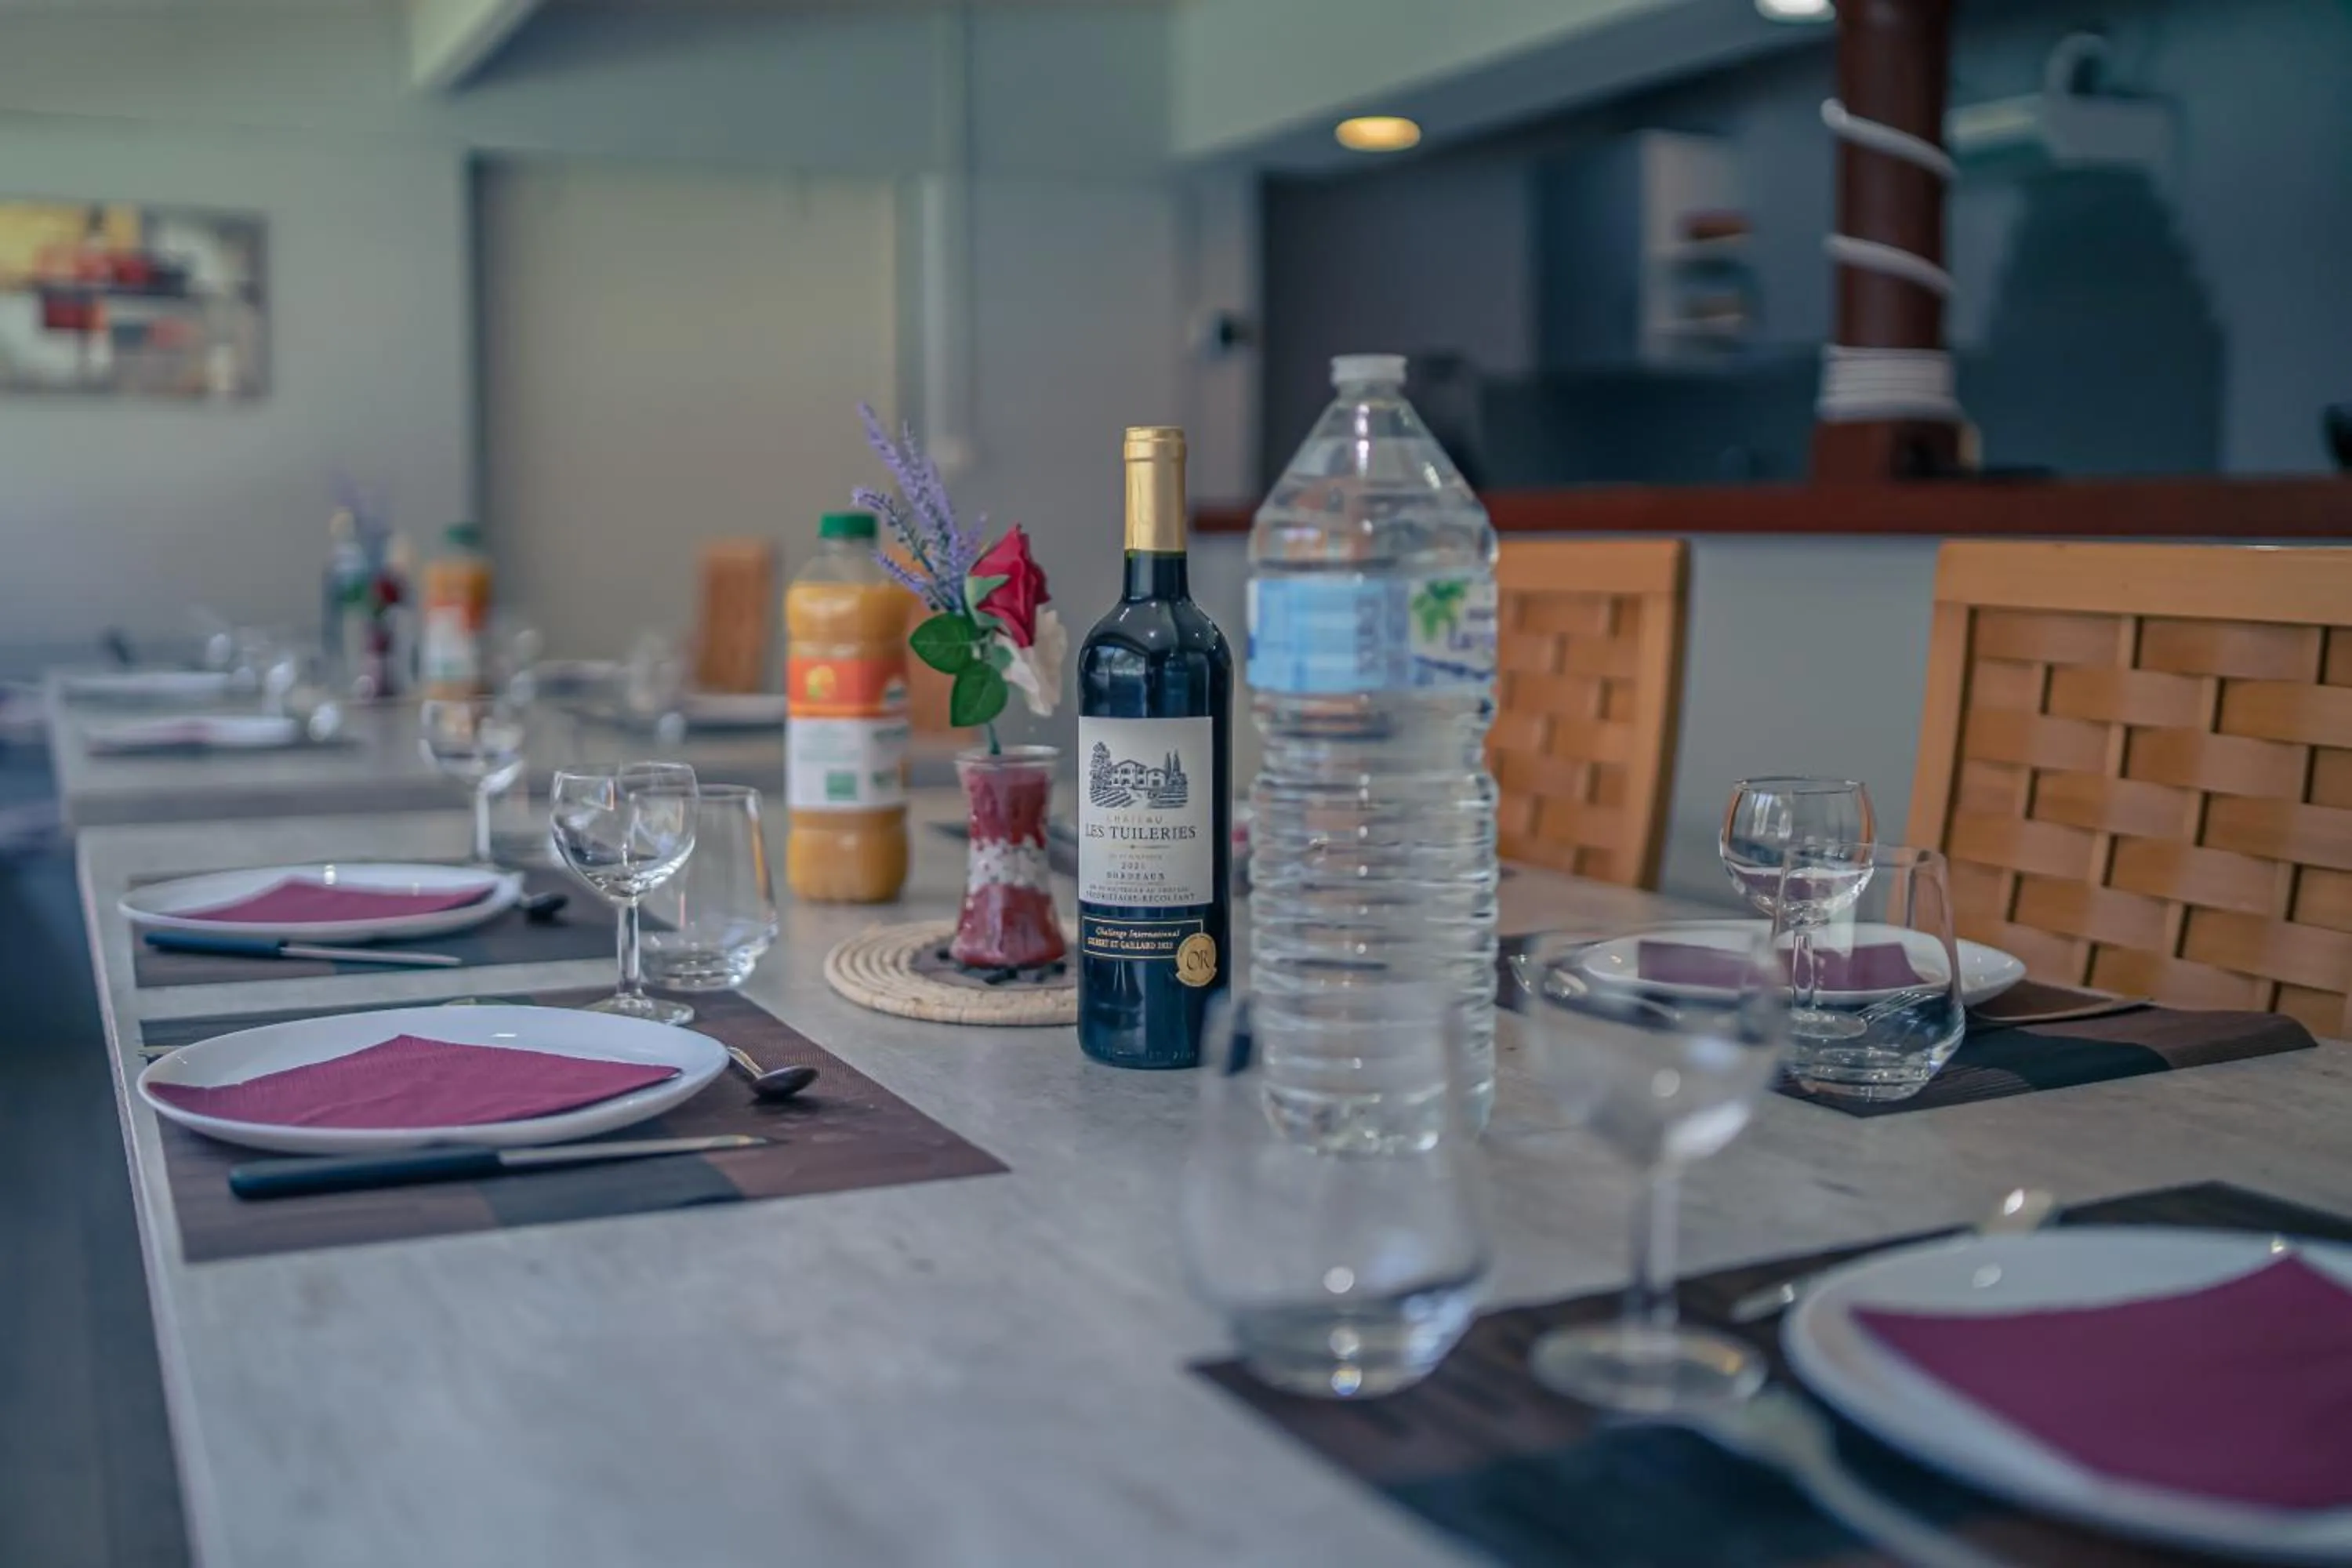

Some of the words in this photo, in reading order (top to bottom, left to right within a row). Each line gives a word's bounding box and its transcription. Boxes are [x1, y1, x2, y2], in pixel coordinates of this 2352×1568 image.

[1085, 823, 1105, 838] LES
[1110, 826, 1197, 840] TUILERIES
[1186, 949, 1210, 971] OR
